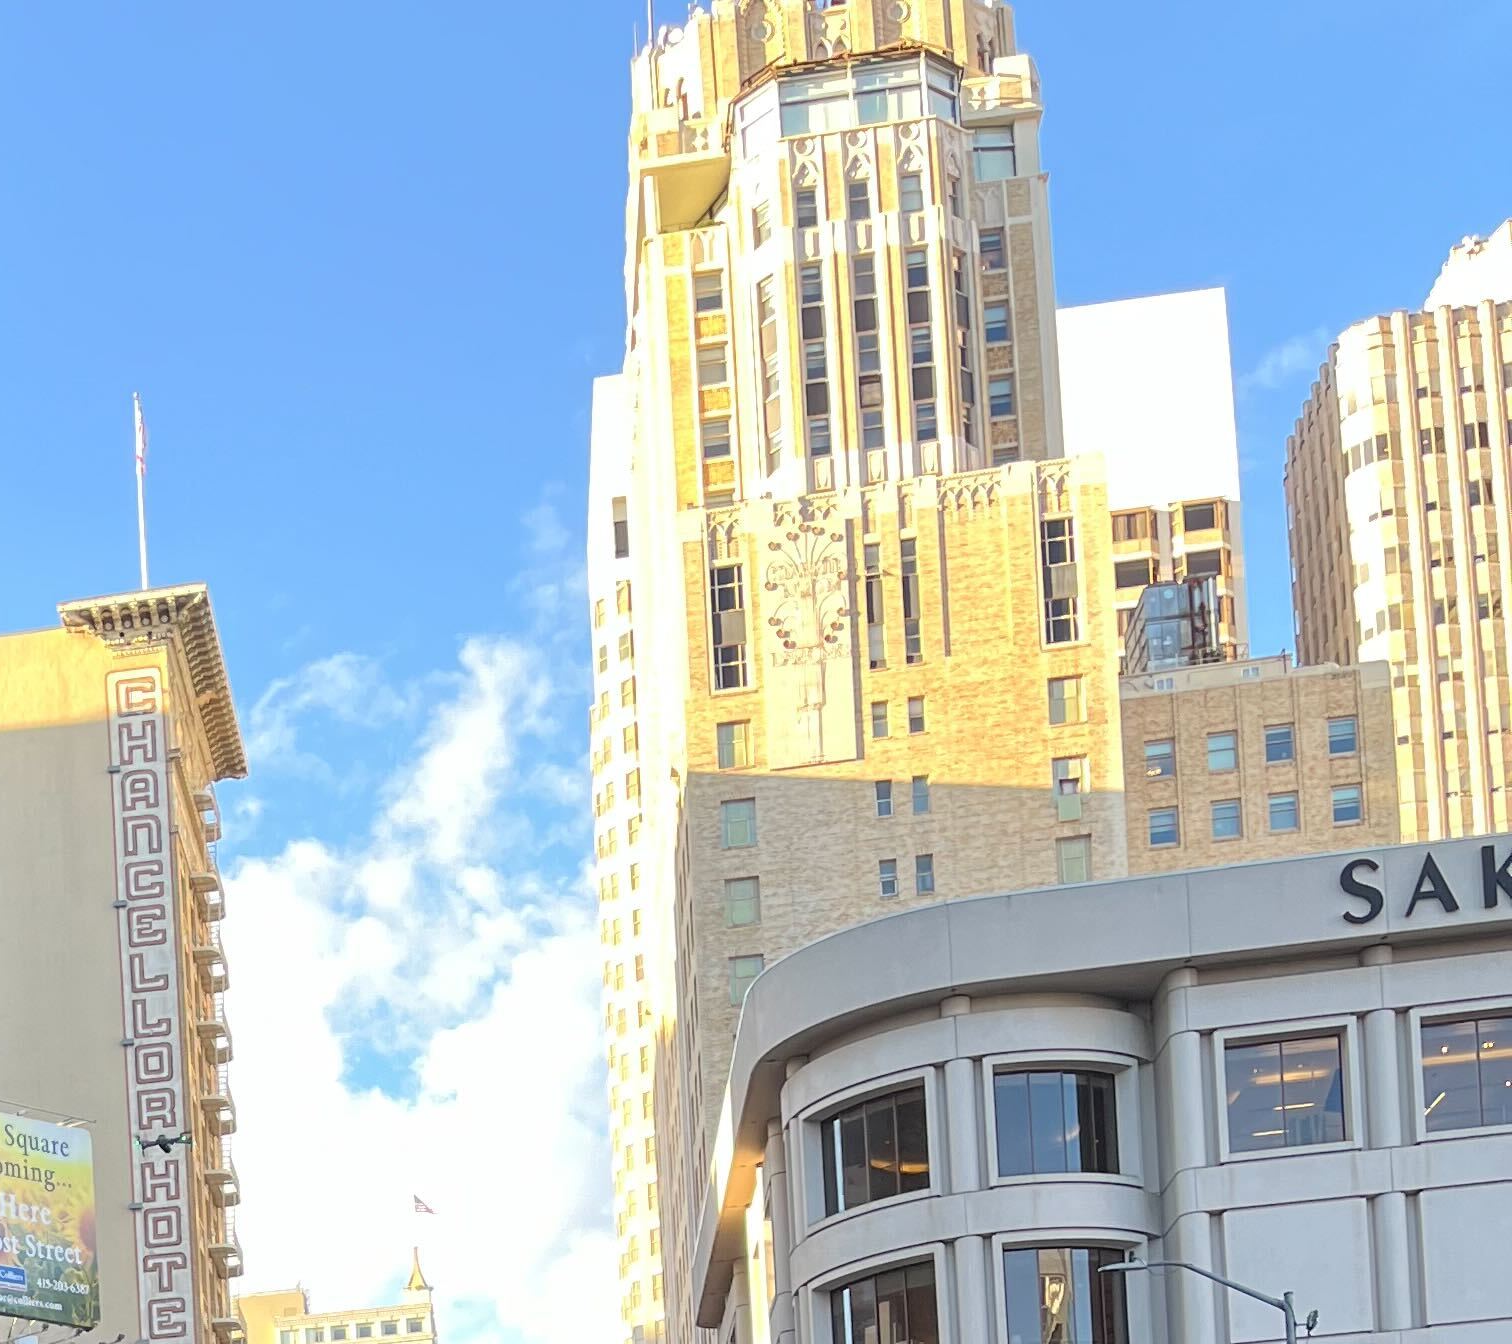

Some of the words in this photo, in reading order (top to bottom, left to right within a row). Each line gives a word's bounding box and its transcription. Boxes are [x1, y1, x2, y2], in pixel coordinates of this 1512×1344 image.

[115, 676, 177, 1130] CHANCELLOR
[5, 1124, 70, 1157] Square
[25, 1234, 83, 1265] Street
